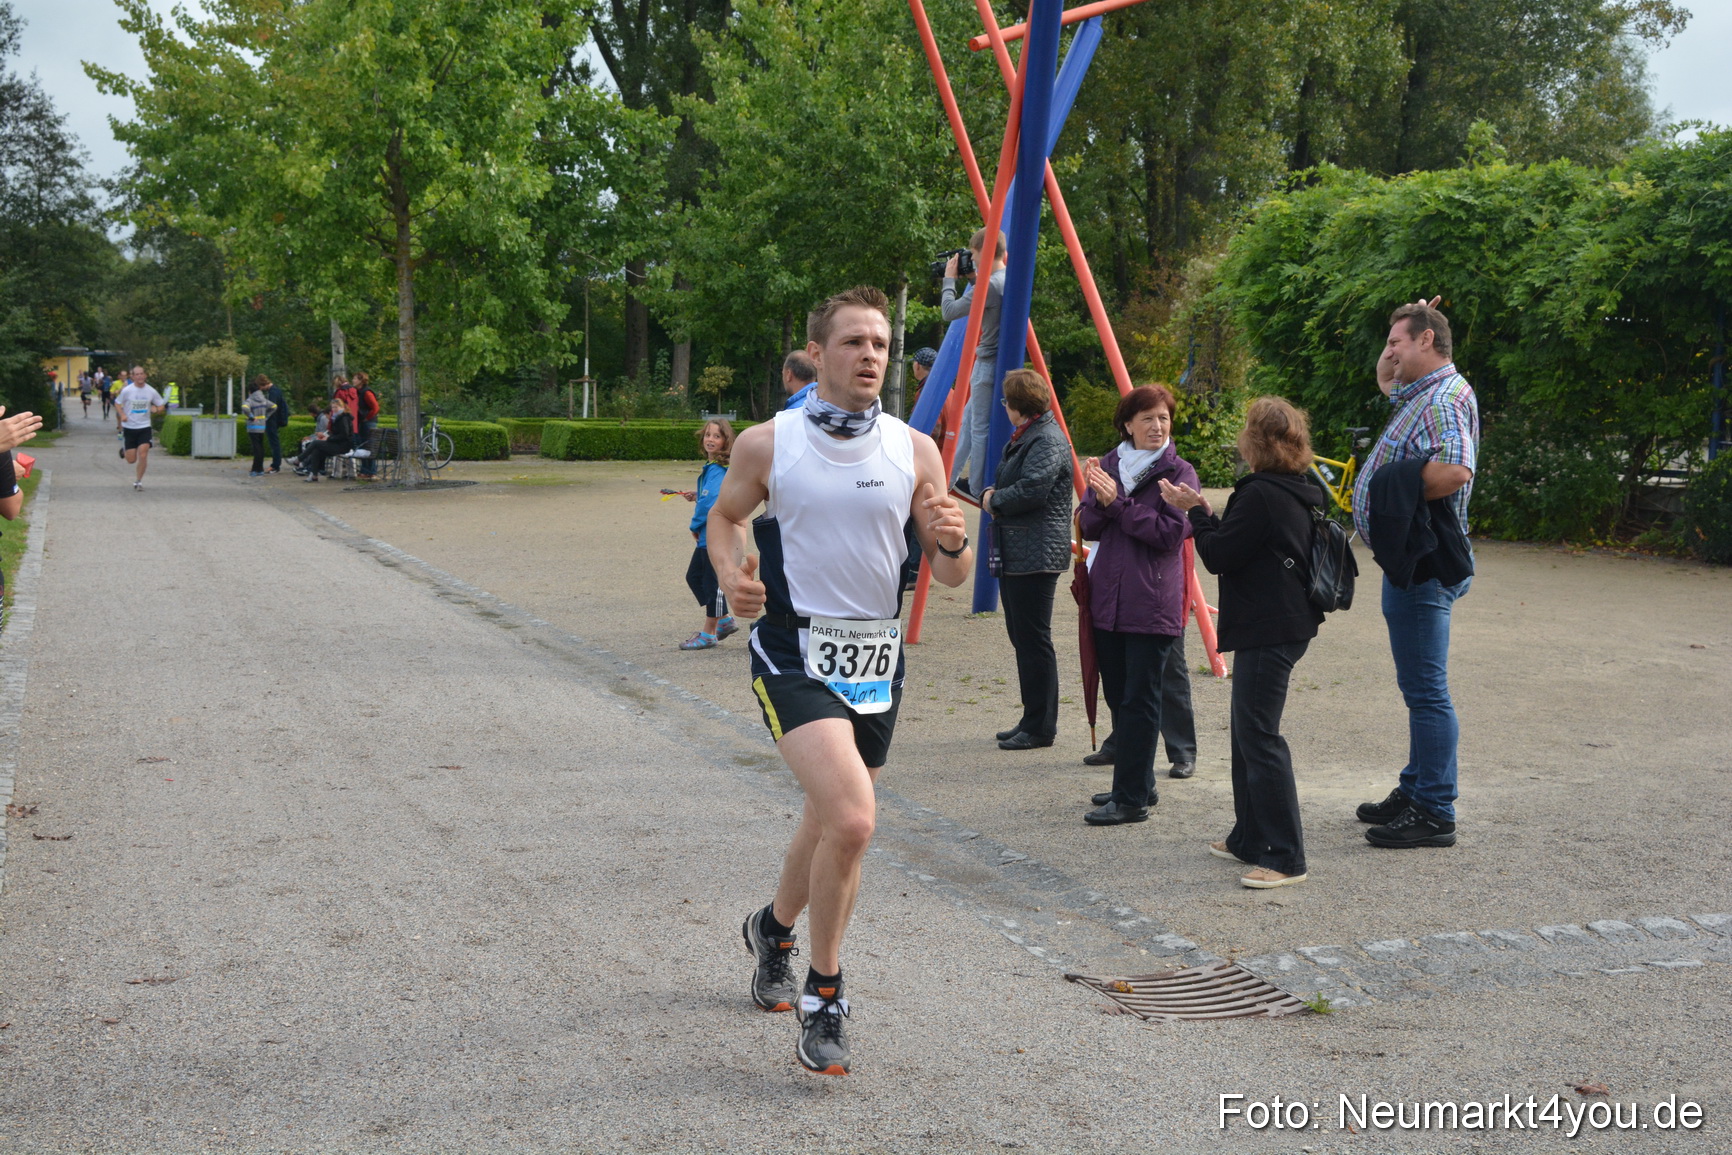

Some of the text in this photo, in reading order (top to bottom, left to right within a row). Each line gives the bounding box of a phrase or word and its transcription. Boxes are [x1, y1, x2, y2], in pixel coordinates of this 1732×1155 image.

[856, 479, 885, 489] Stefan
[811, 626, 887, 639] PARTL Neumarkt
[817, 641, 892, 679] 3376
[834, 682, 878, 705] efan
